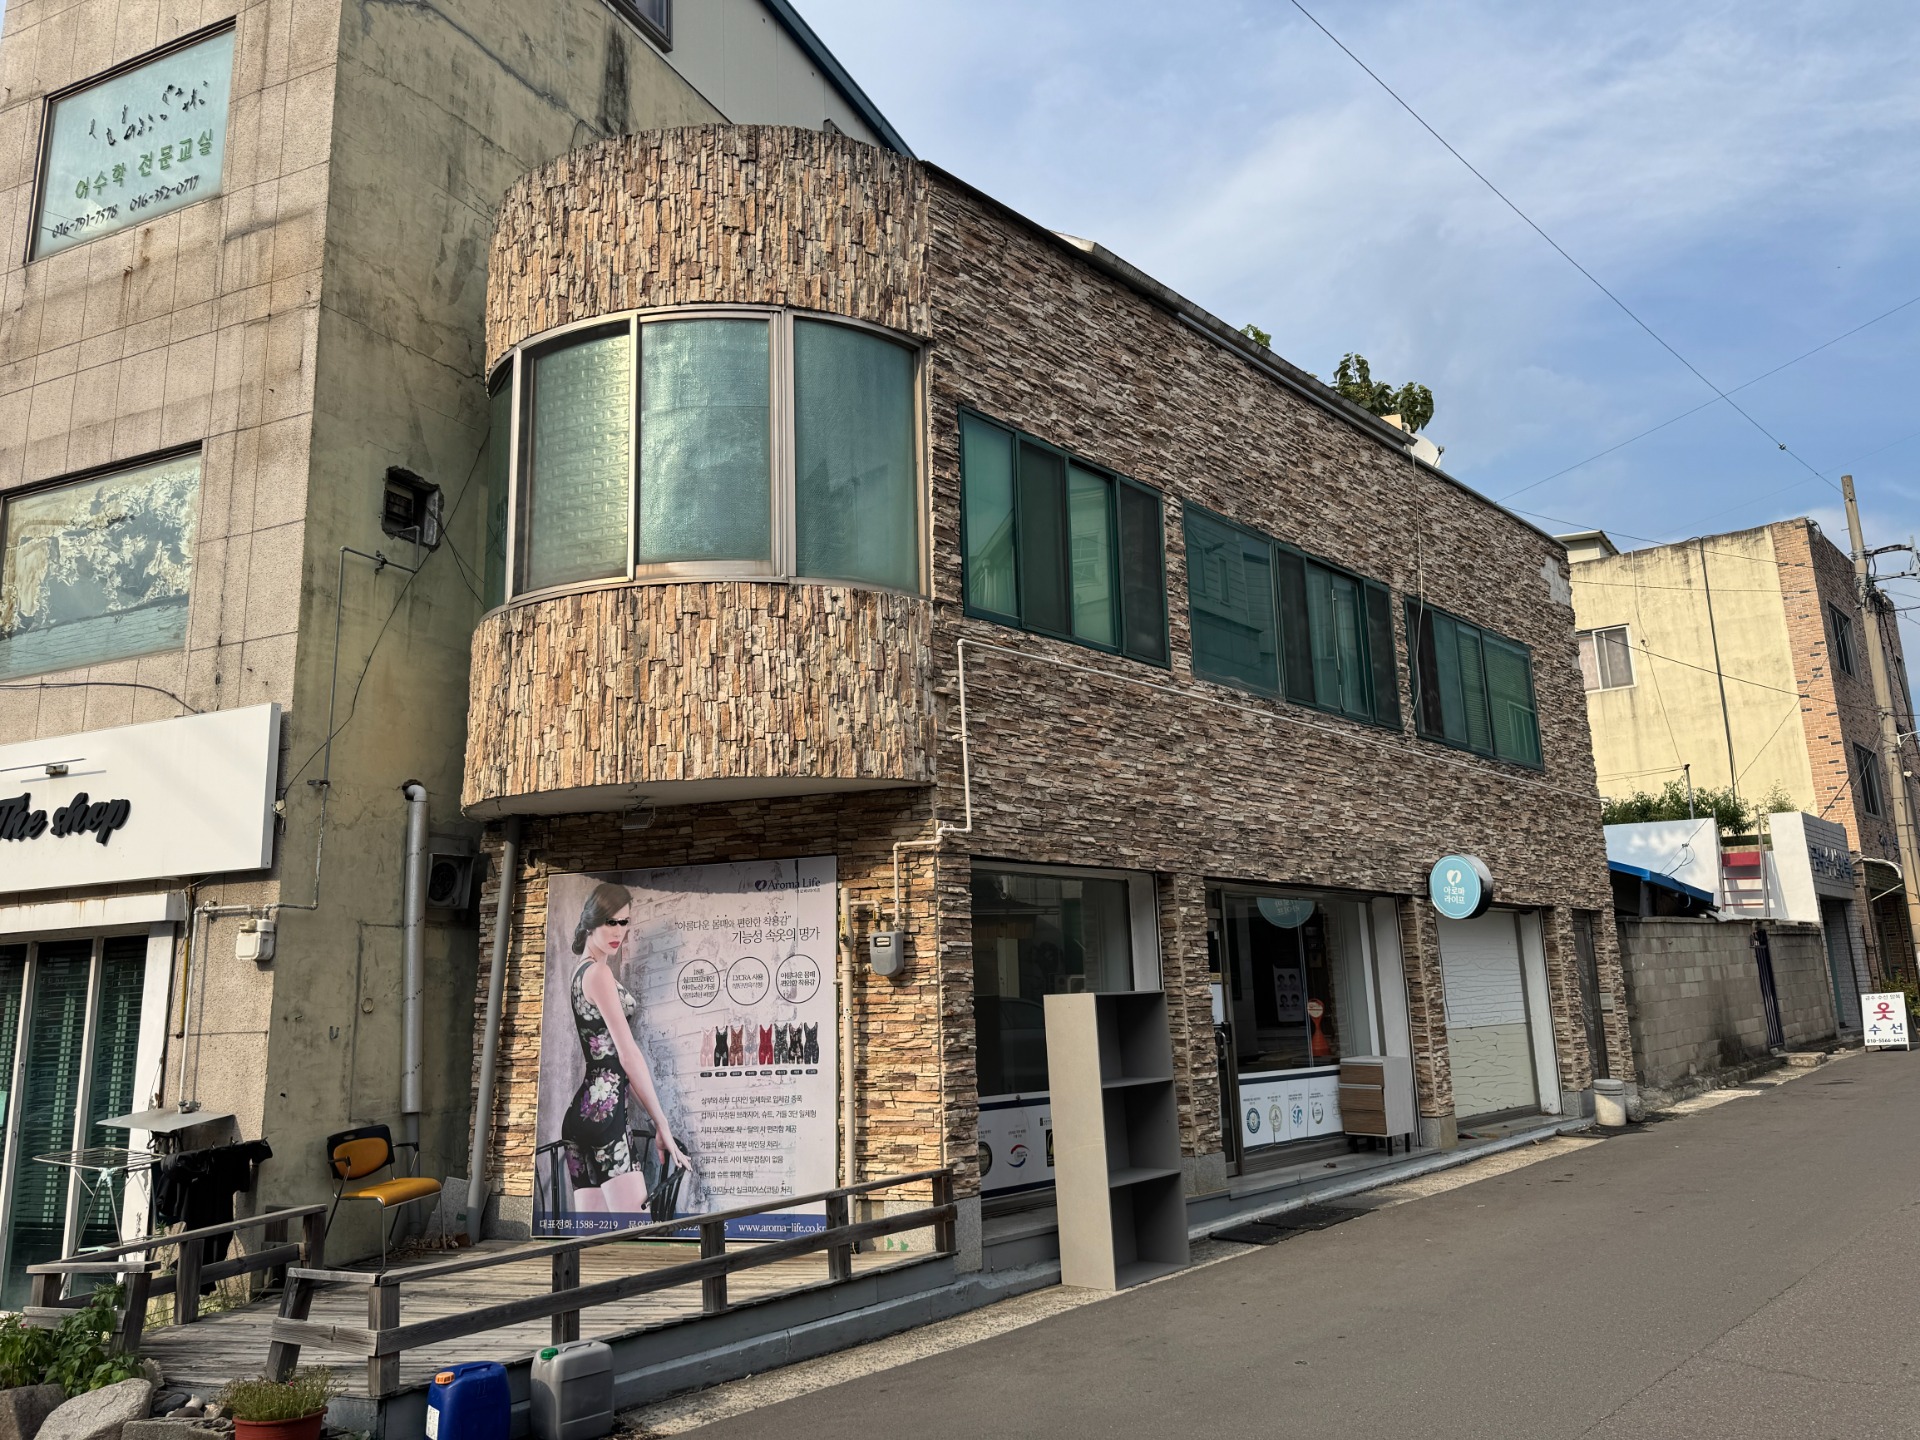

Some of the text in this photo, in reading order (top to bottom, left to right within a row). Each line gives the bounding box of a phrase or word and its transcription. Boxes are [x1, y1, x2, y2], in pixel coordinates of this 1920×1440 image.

[50, 792, 131, 846] shop
[767, 876, 821, 891] Aroma Life
[1443, 886, 1465, 895] 아로마
[1444, 895, 1465, 905] 라이프
[732, 926, 821, 944] 기능성 속옷의 명가
[1872, 1001, 1895, 1021] 옷
